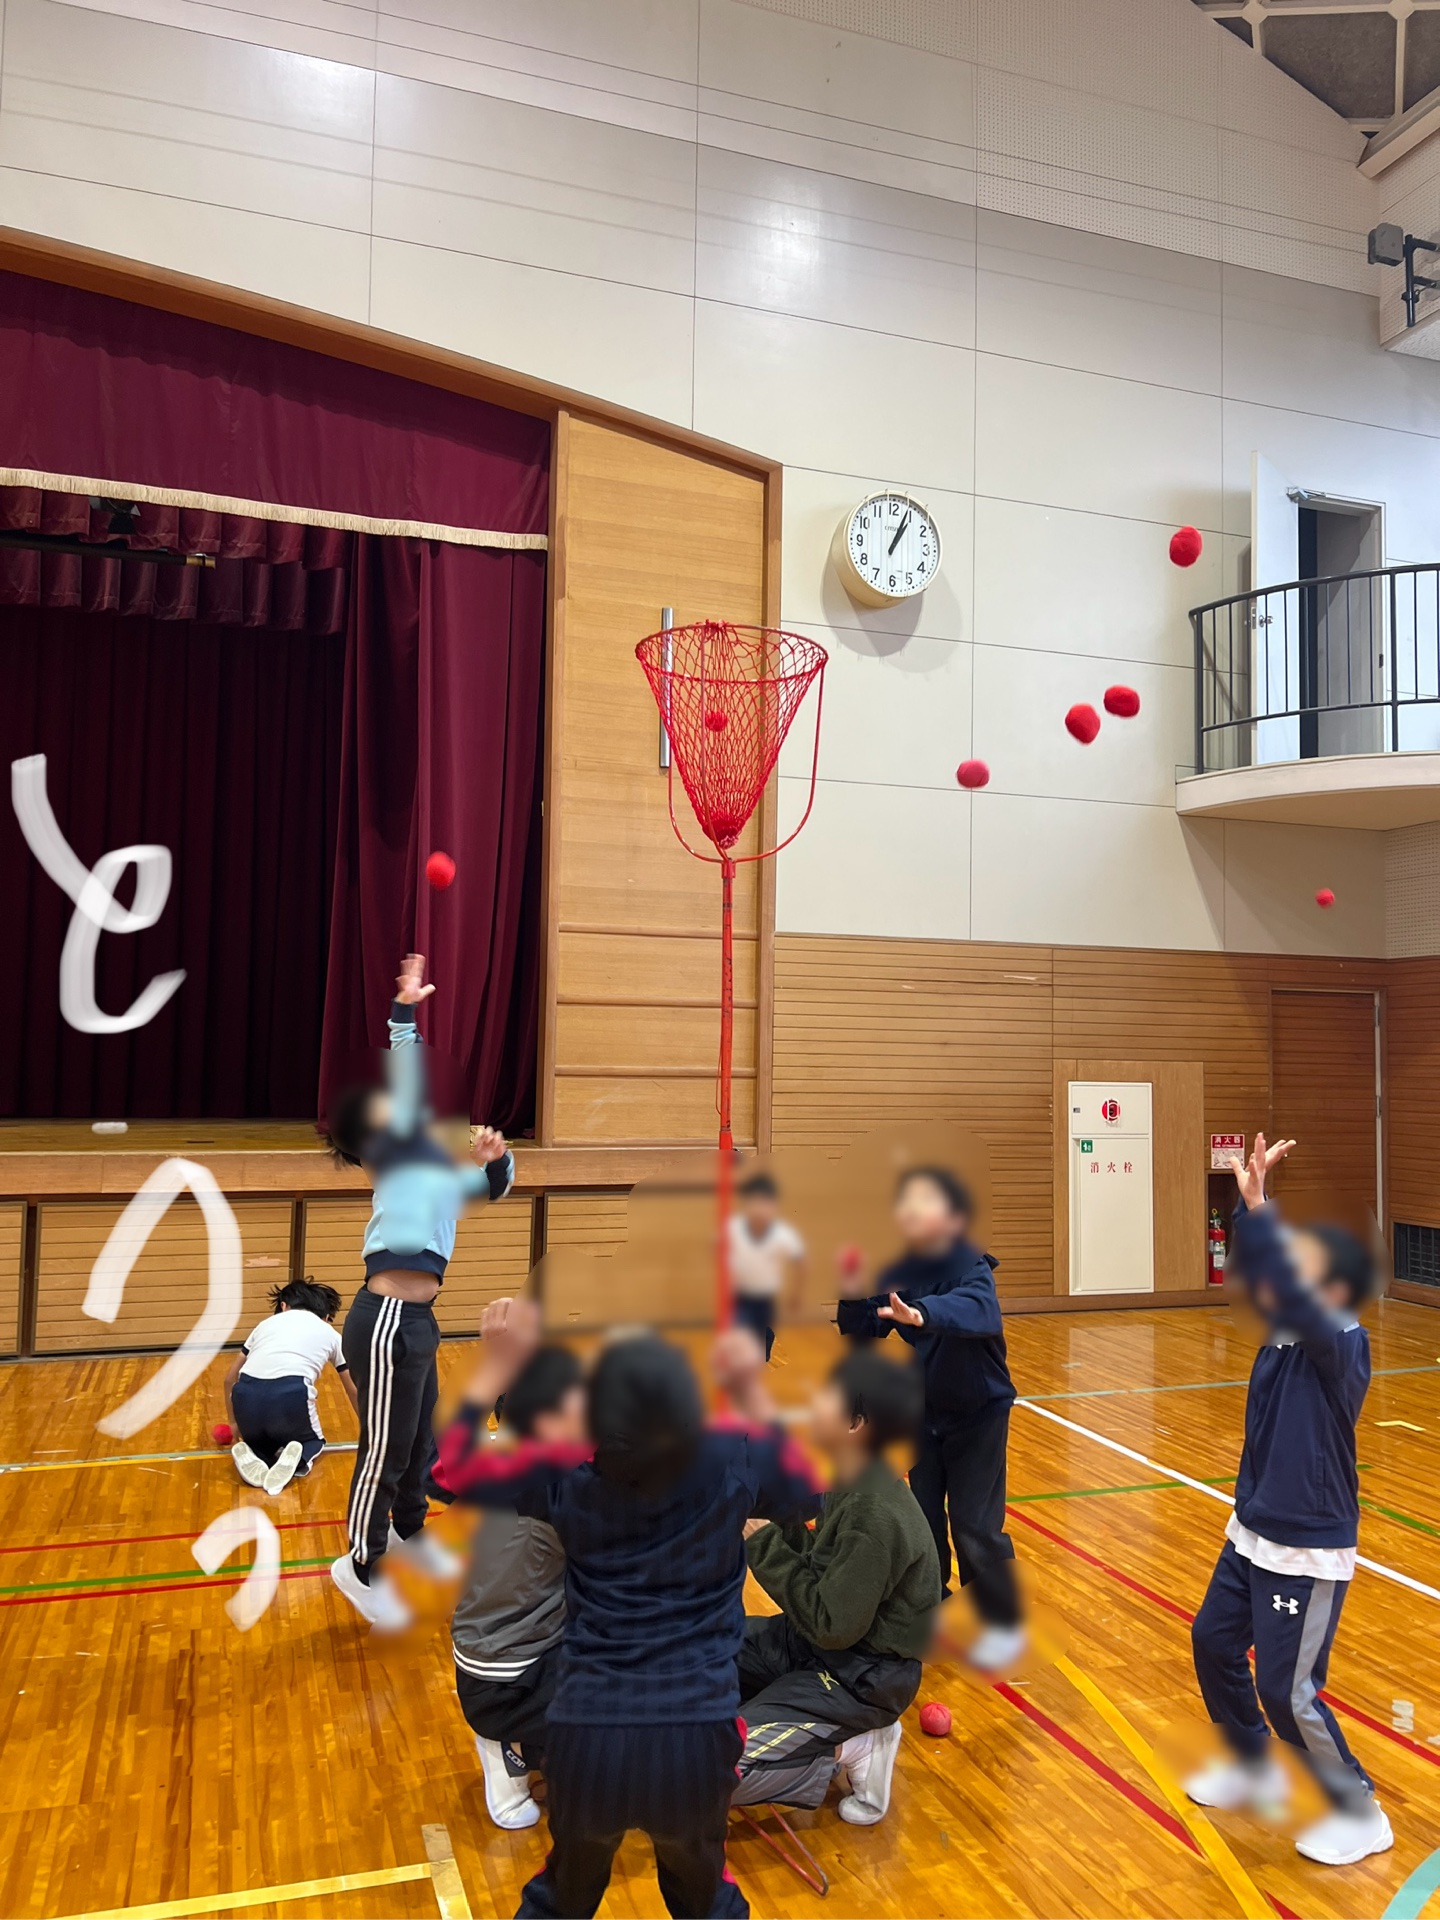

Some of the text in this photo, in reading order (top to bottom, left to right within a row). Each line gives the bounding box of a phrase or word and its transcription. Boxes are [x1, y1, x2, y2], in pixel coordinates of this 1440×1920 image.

[874, 505, 881, 518] 11
[889, 502, 900, 516] 12
[860, 515, 870, 529] 10
[920, 525, 927, 538] 2
[856, 534, 863, 546] 9
[922, 544, 930, 556] 3
[860, 553, 868, 565] 8
[872, 567, 880, 580] 7
[917, 561, 926, 574] 4
[889, 575, 896, 587] 6
[906, 572, 913, 585] 5
[1090, 1161, 1133, 1174] 消火栓
